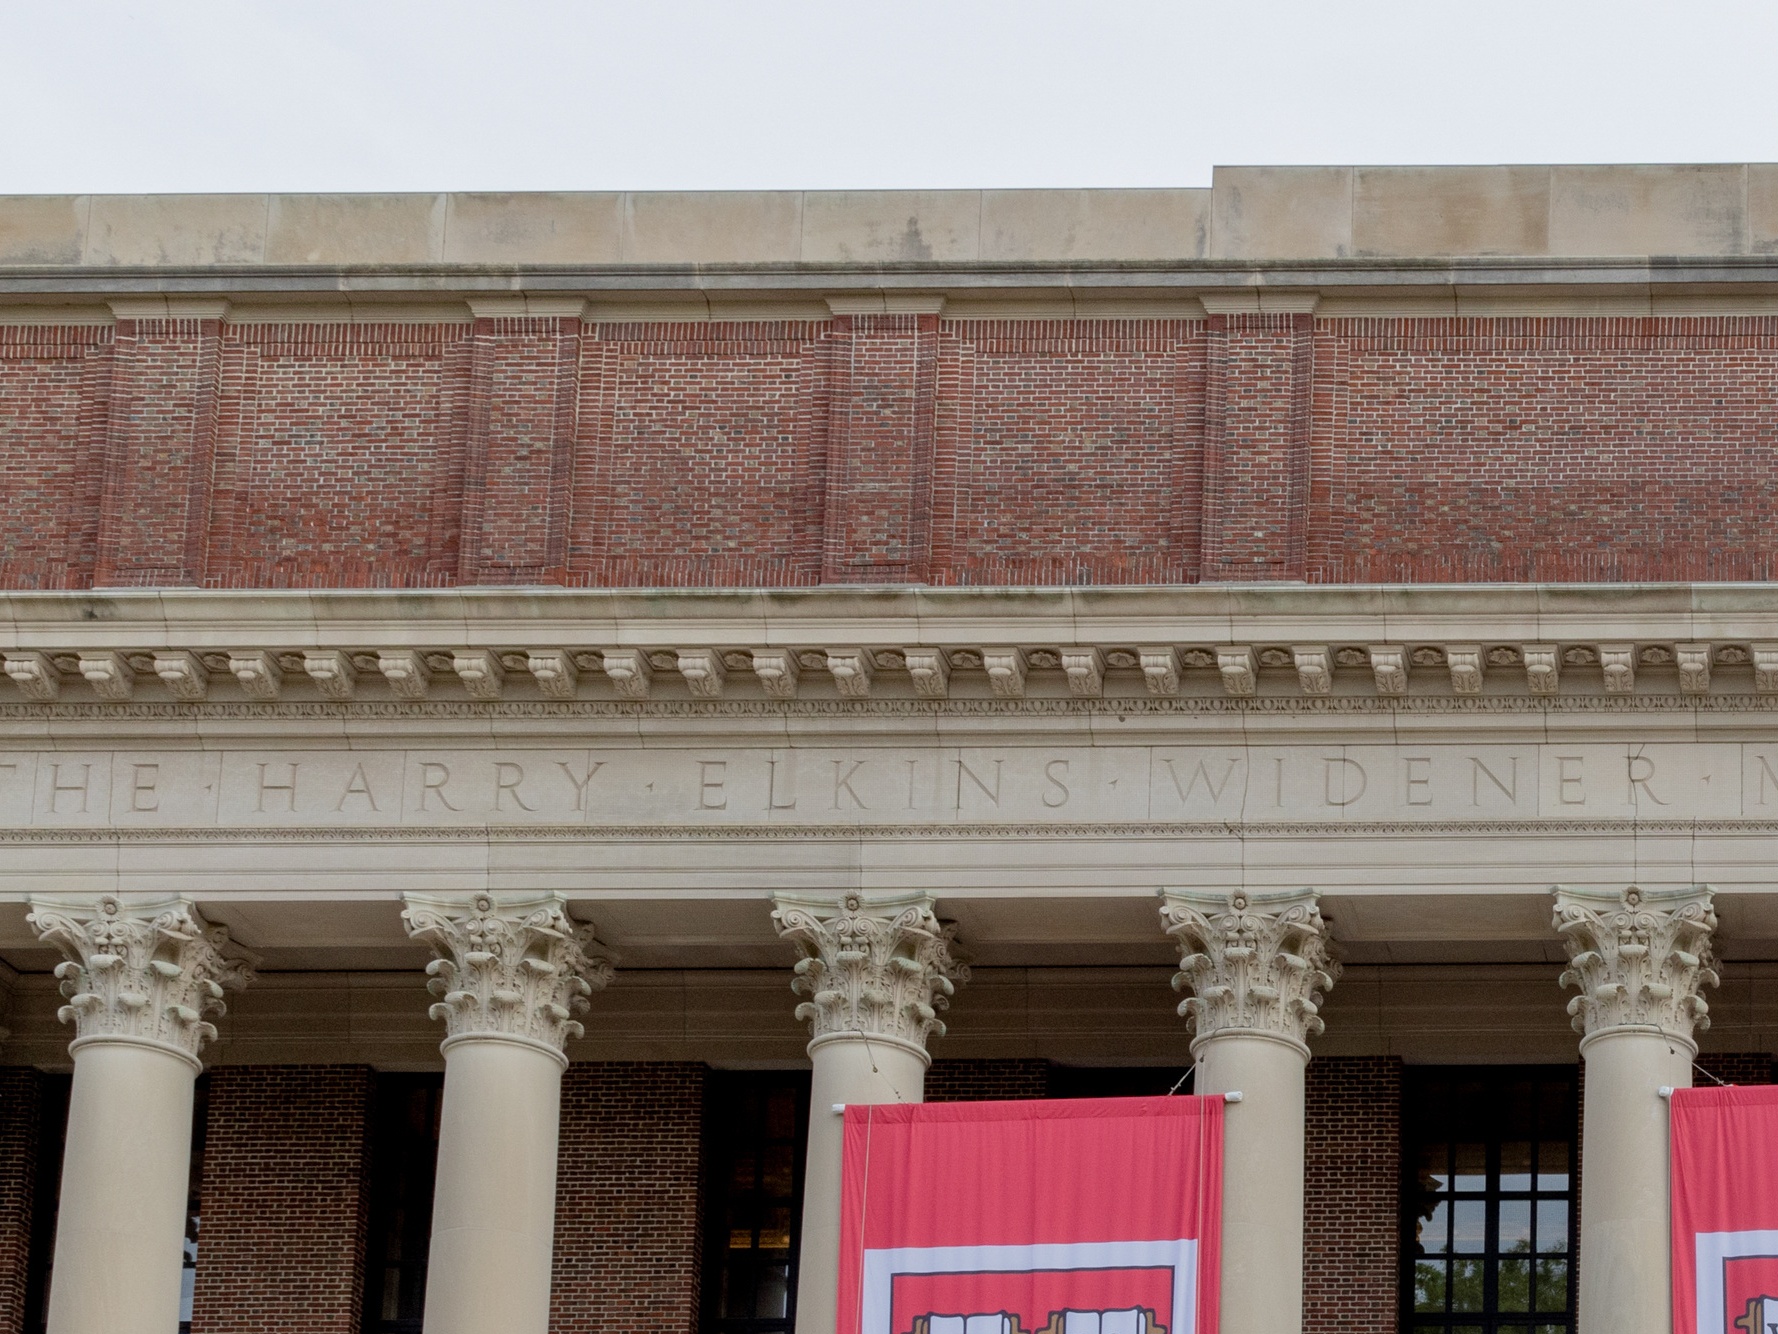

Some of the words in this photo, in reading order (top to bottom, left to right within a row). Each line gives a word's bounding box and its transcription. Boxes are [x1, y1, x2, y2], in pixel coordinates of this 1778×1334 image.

[0, 763, 160, 813] HE
[253, 762, 605, 813] HARRY
[693, 758, 1071, 812] ELKINS
[1161, 756, 1671, 808] WIDENER
